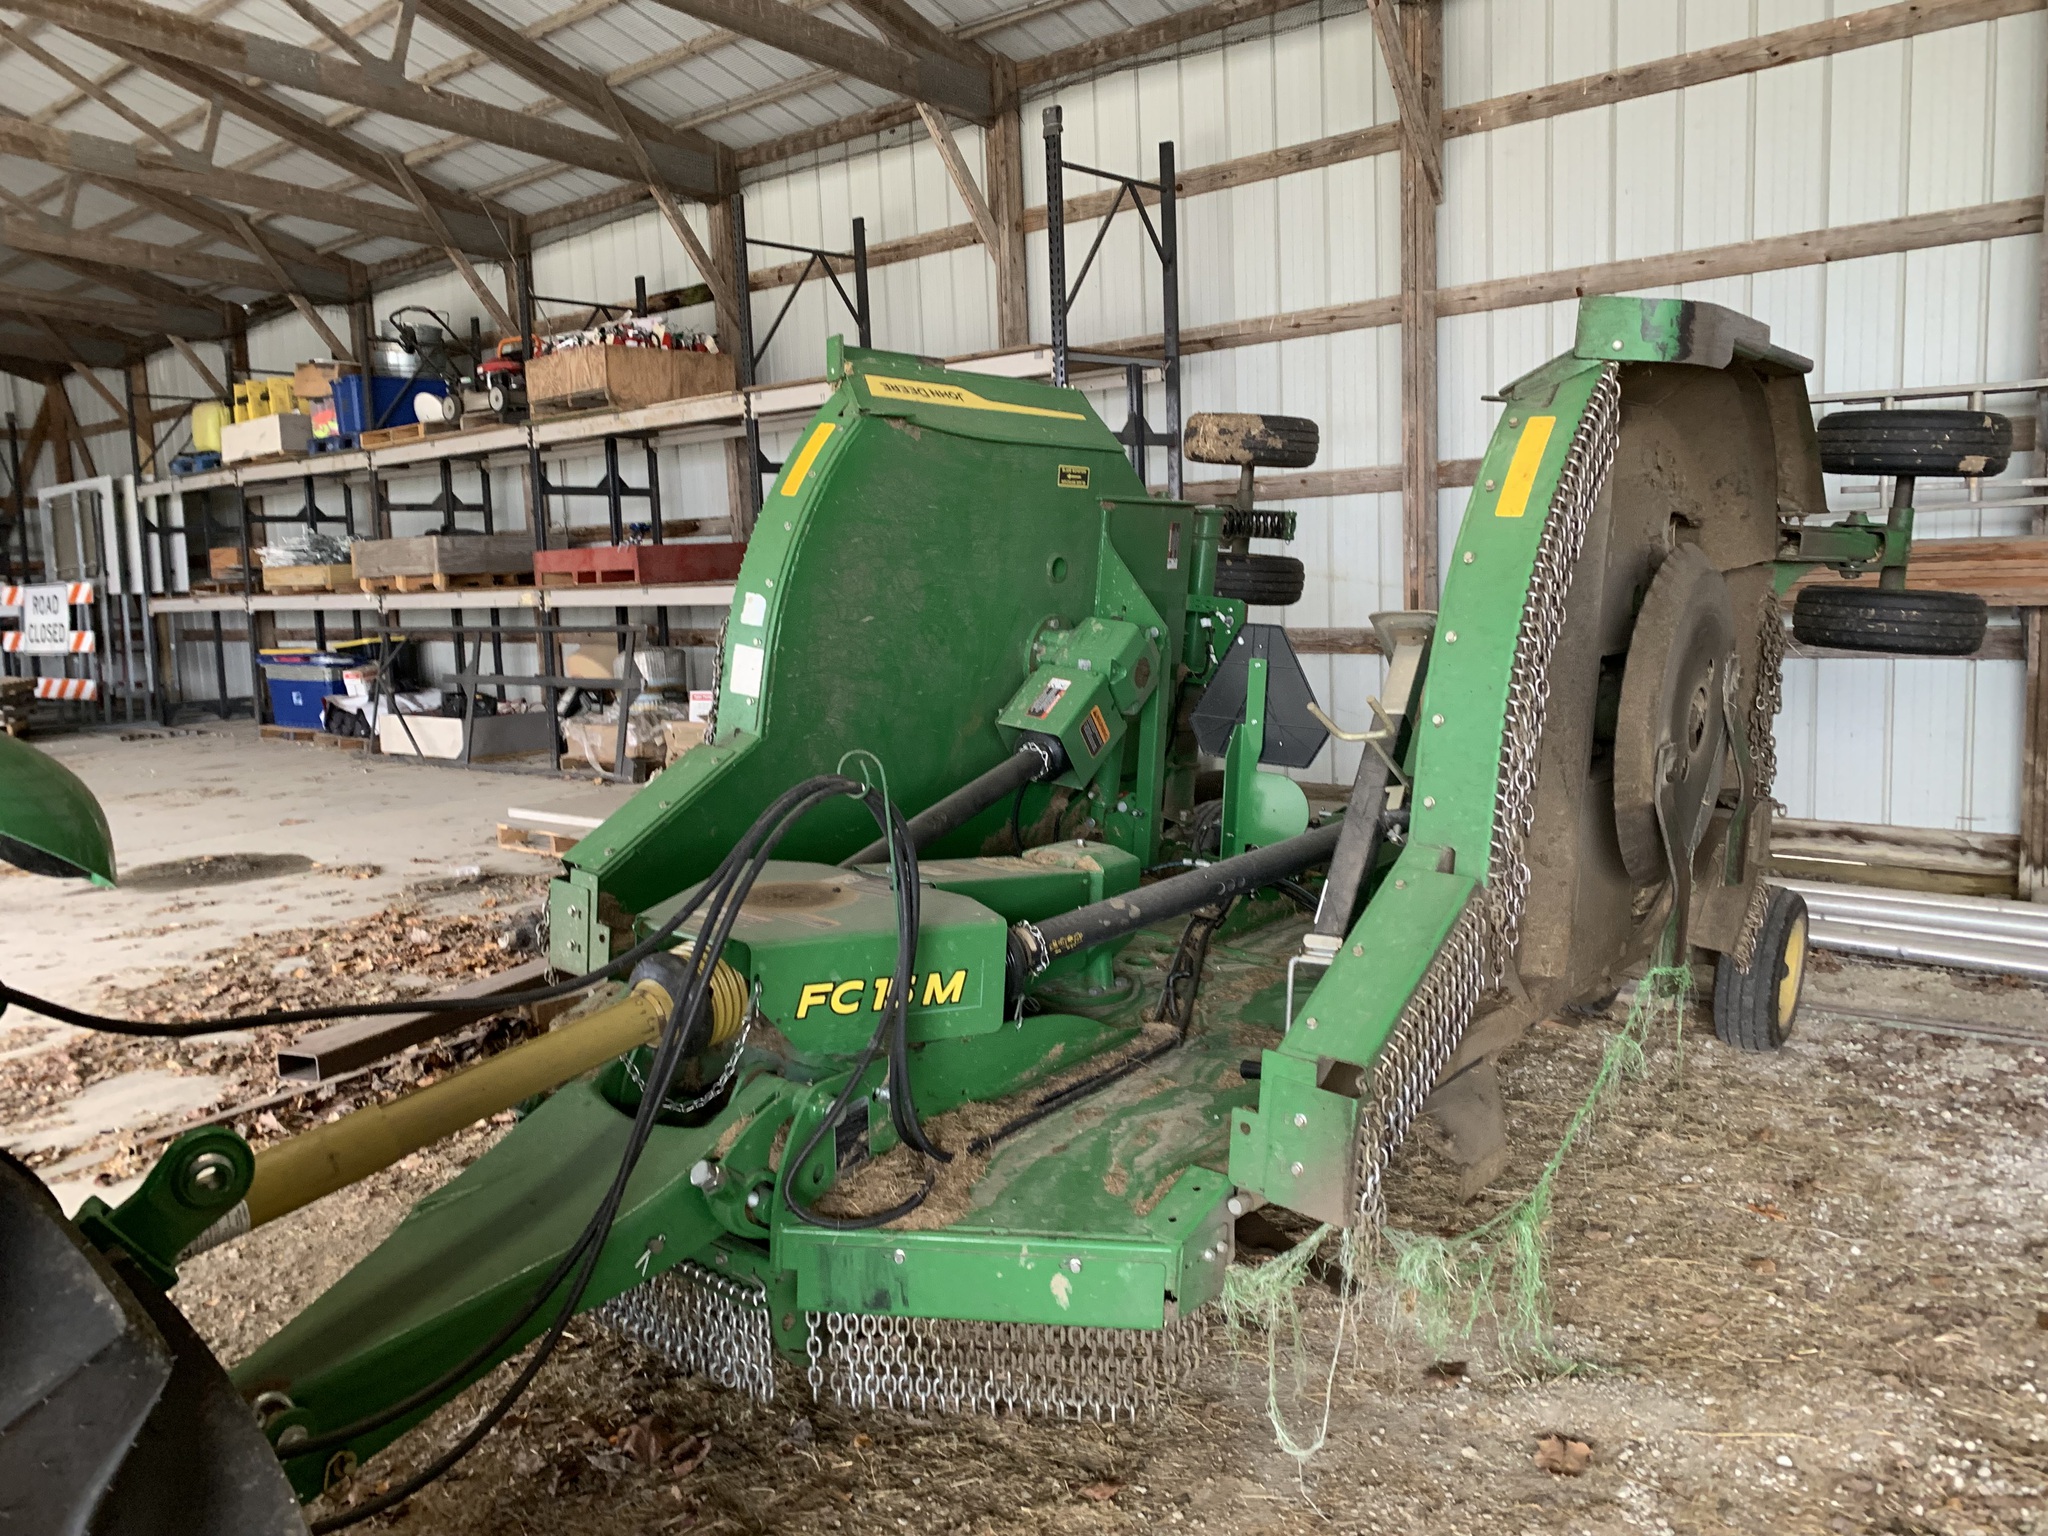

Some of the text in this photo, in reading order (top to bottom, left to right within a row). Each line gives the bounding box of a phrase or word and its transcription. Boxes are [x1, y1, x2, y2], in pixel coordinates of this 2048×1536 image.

[880, 382, 965, 402] JOHN DEERE
[33, 595, 58, 615] ROAD
[28, 623, 65, 643] CLOSED
